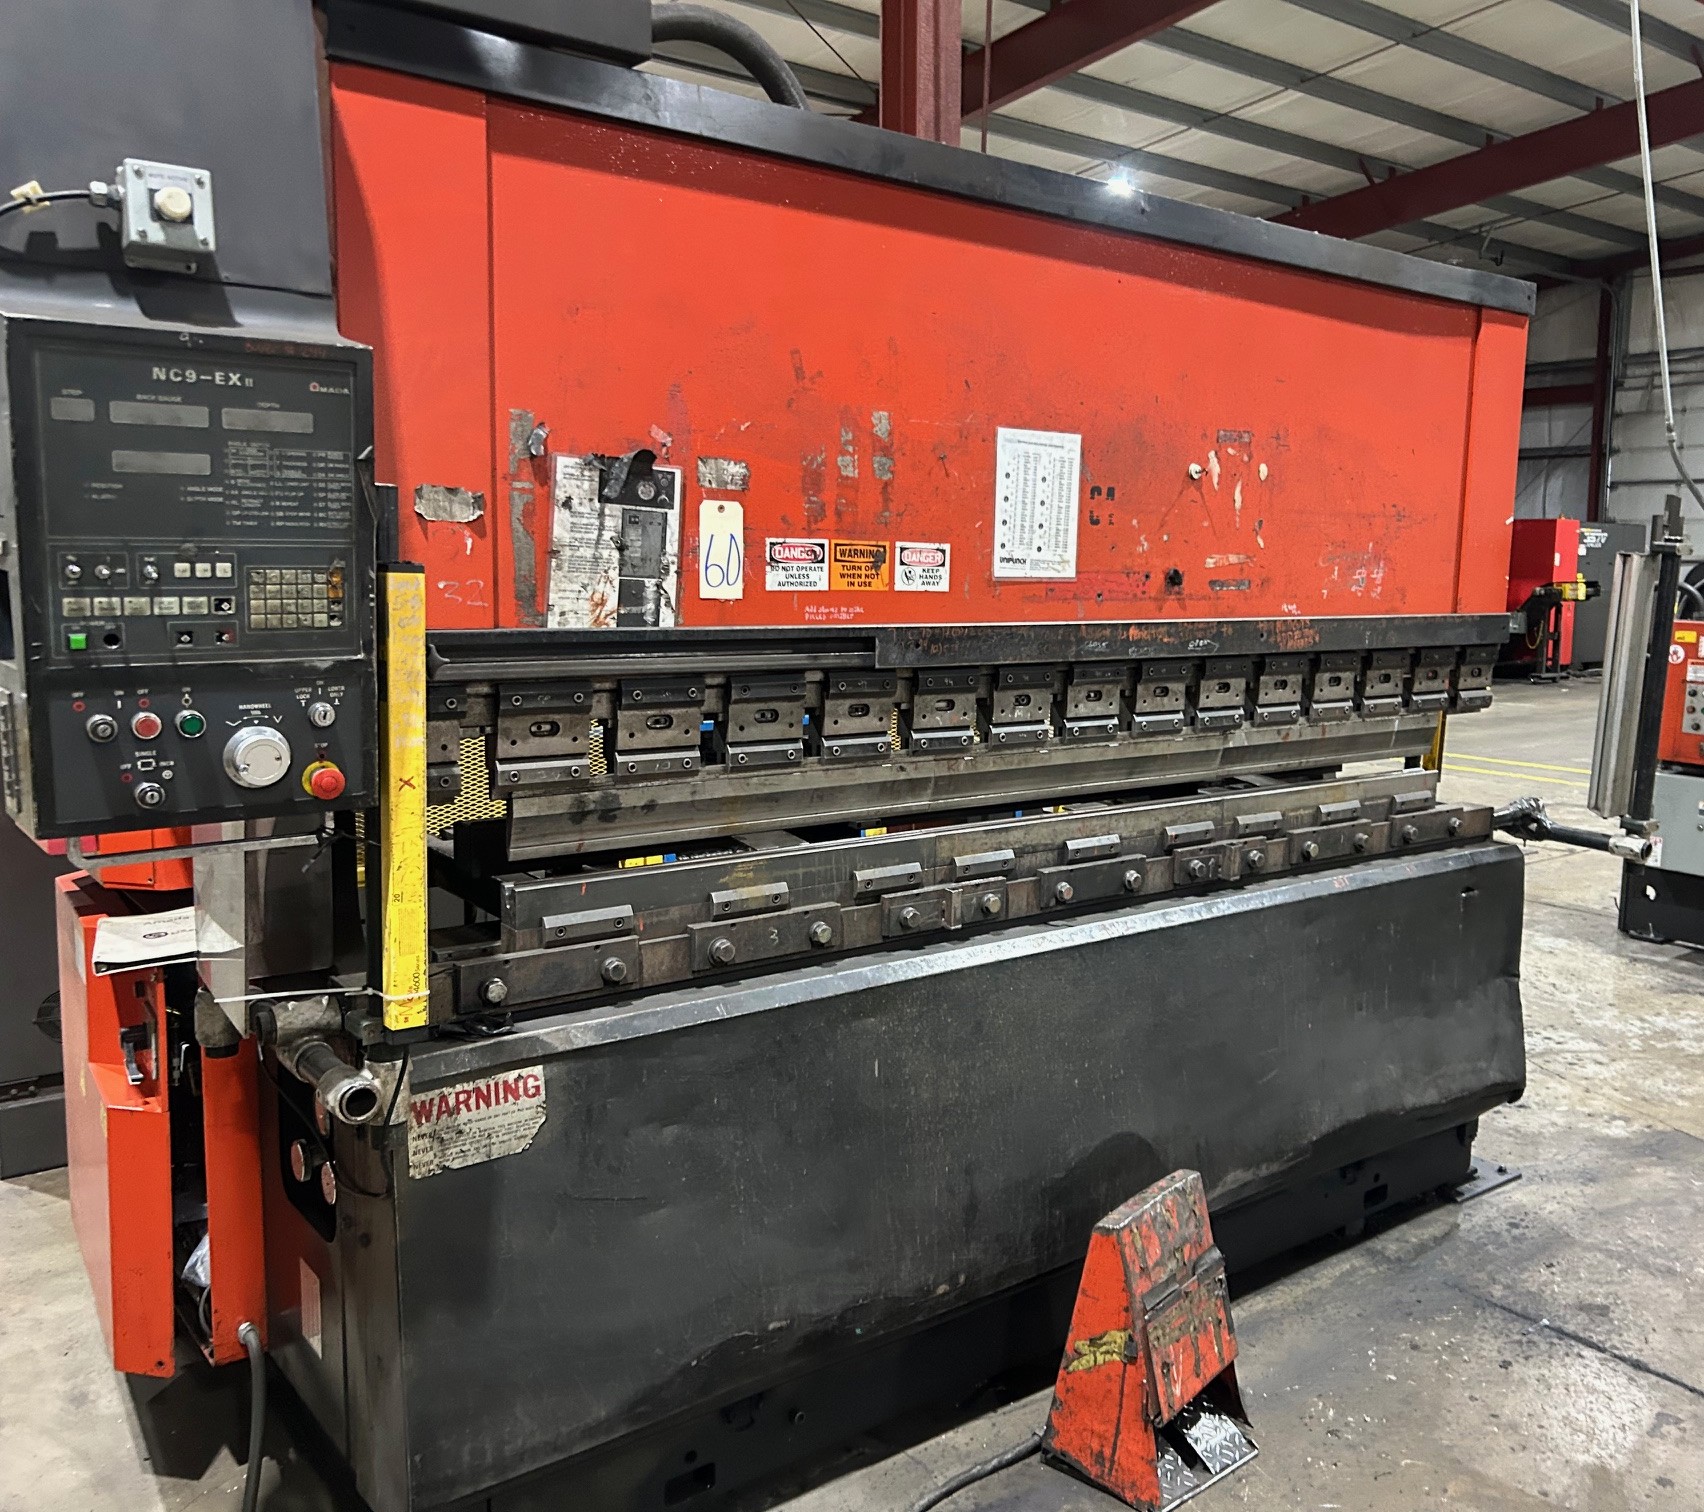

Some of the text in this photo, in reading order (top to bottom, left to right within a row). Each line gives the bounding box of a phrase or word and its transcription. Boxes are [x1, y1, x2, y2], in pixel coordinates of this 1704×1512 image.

[704, 533, 741, 588] 60
[904, 551, 942, 565] DANGER
[781, 565, 795, 573] NOT
[796, 565, 824, 573] OPERATE
[841, 564, 863, 572] TURN
[839, 572, 879, 580] WHEN NOT
[847, 580, 873, 588] IN USE
[134, 750, 157, 758] SINGLE
[393, 893, 401, 903] 20
[410, 1074, 541, 1126] WARNING
[413, 1158, 435, 1170] NEVER
